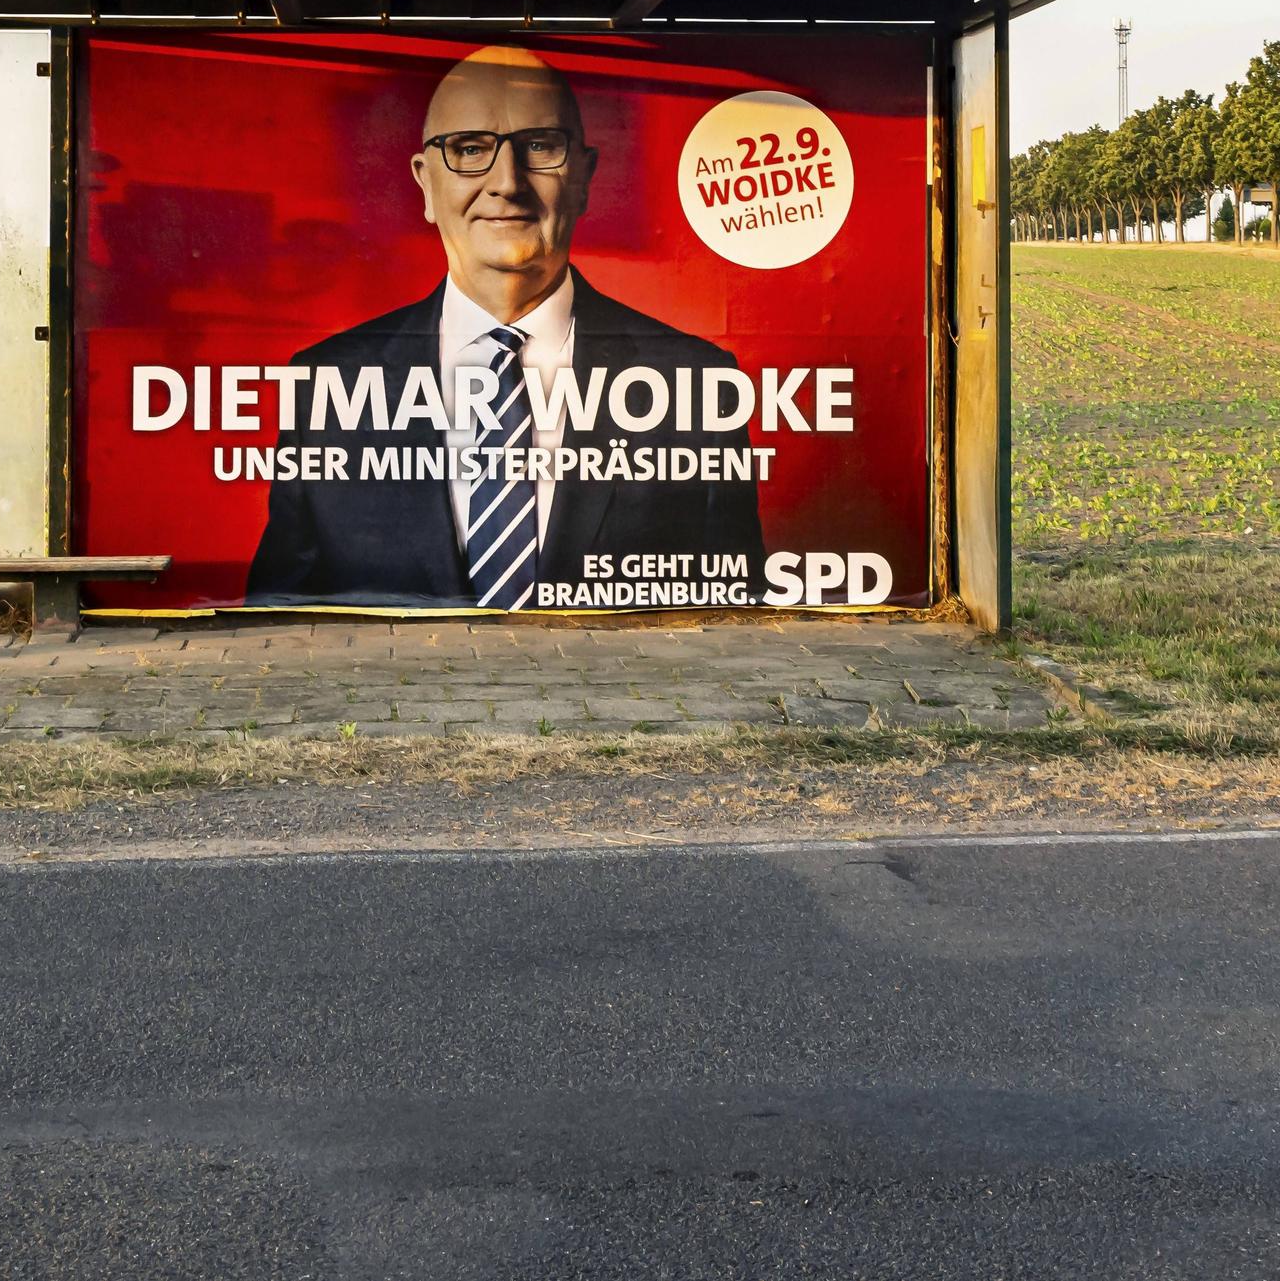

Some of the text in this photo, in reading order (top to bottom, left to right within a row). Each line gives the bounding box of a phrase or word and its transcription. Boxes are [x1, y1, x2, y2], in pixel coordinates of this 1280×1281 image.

[695, 126, 831, 178] Am 22.9.
[696, 161, 836, 208] WOIDKE
[720, 196, 825, 234] wählen!
[132, 365, 854, 432] DIETMAR WOIDKE
[214, 438, 776, 481] UNSER MINISTERPRÄSIDENT
[583, 554, 749, 578] ES GEHT UM
[762, 551, 894, 607] SPD
[538, 582, 757, 606] BRANDENBURG.
